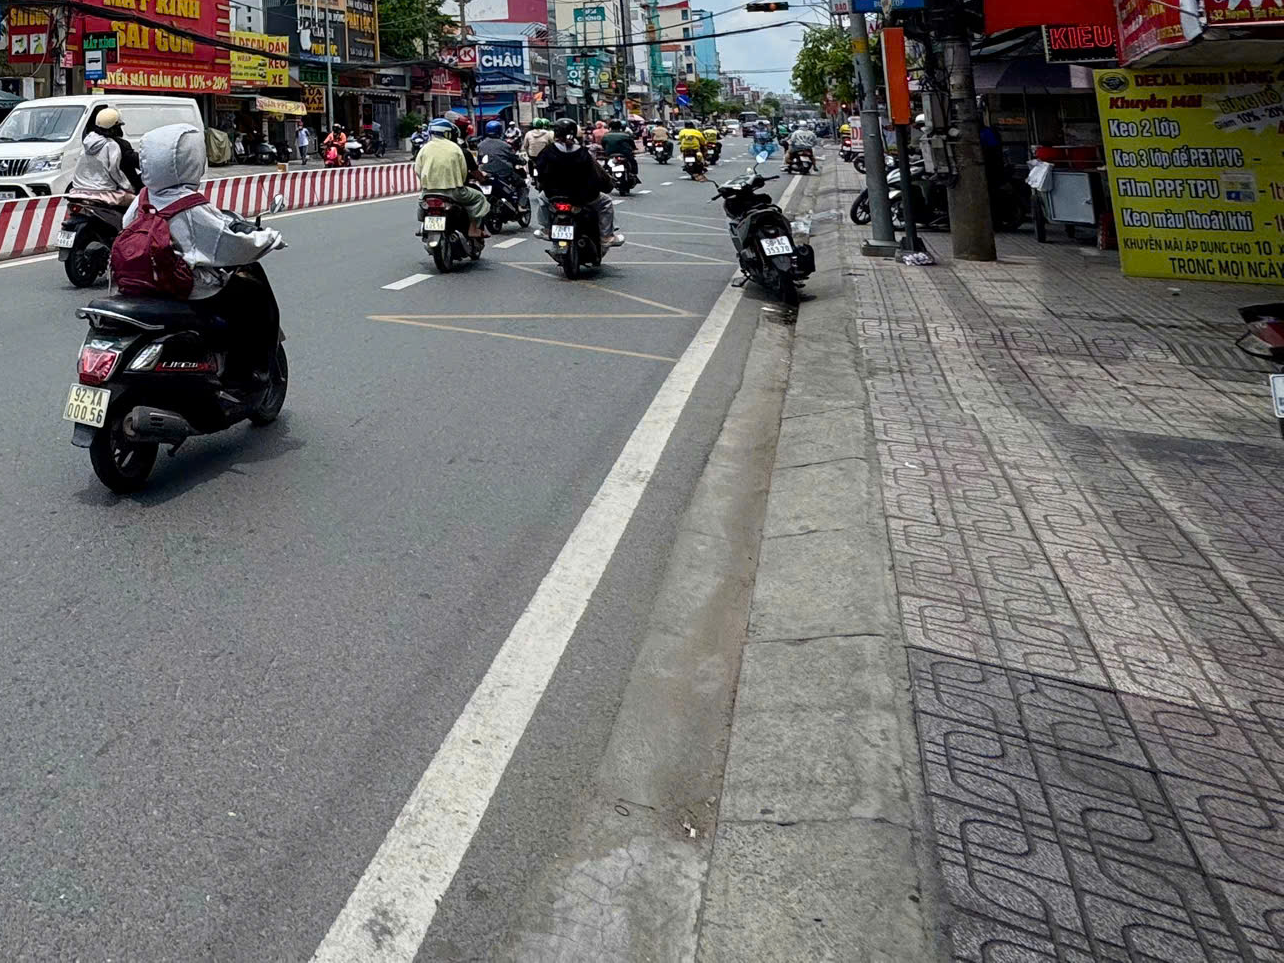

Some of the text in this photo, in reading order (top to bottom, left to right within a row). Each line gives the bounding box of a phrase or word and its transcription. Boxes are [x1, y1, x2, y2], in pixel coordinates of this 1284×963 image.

[268, 38, 288, 54] DÁN
[268, 57, 287, 70] KEO
[481, 52, 522, 67] CHÂU
[130, 70, 148, 87] MÃI
[149, 70, 172, 88] GIẢM
[173, 73, 187, 89] GIÁ
[189, 74, 206, 89] 10%
[271, 73, 284, 86] XE
[1134, 74, 1182, 88] DECAL
[1108, 116, 1181, 139] Keo 2 lớp
[1112, 148, 1138, 168] Keo
[1138, 149, 1149, 167] 3
[1149, 147, 1169, 170] lớp
[1190, 148, 1216, 168] PET
[1216, 147, 1245, 168] PVC
[1117, 177, 1152, 198] Film
[1153, 178, 1186, 199] PPF
[1187, 178, 1220, 199] TPU
[1121, 207, 1150, 228] Keo
[1152, 208, 1186, 230] màu
[1227, 210, 1255, 232] khí
[1229, 241, 1251, 255] CHO
[1254, 240, 1273, 256] 10
[1168, 256, 1216, 276] TRONG
[1217, 259, 1245, 280] MỌI
[73, 387, 104, 408] 92-XA
[67, 402, 104, 424] 000.56
